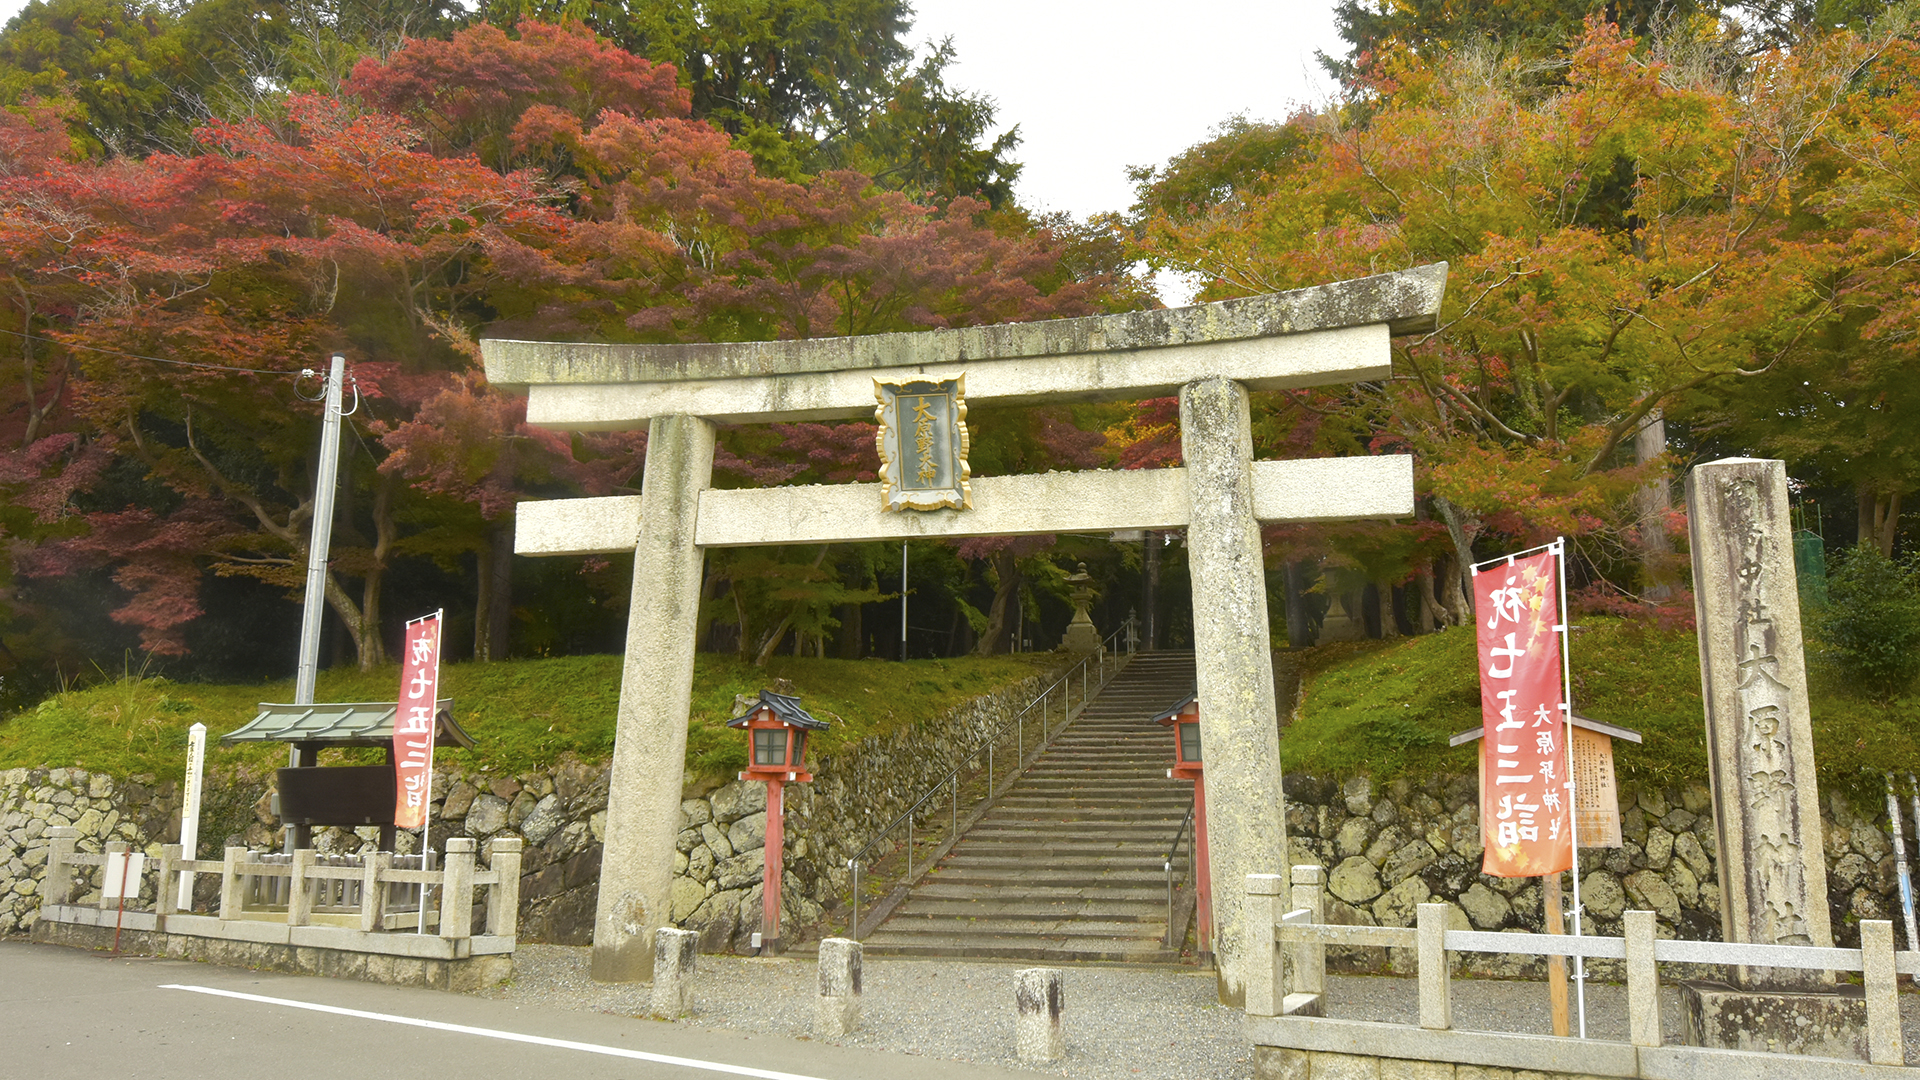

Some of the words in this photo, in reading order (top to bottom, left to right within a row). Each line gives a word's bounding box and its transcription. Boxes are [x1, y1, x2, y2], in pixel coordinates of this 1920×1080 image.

[912, 397, 938, 488] 大原野大神
